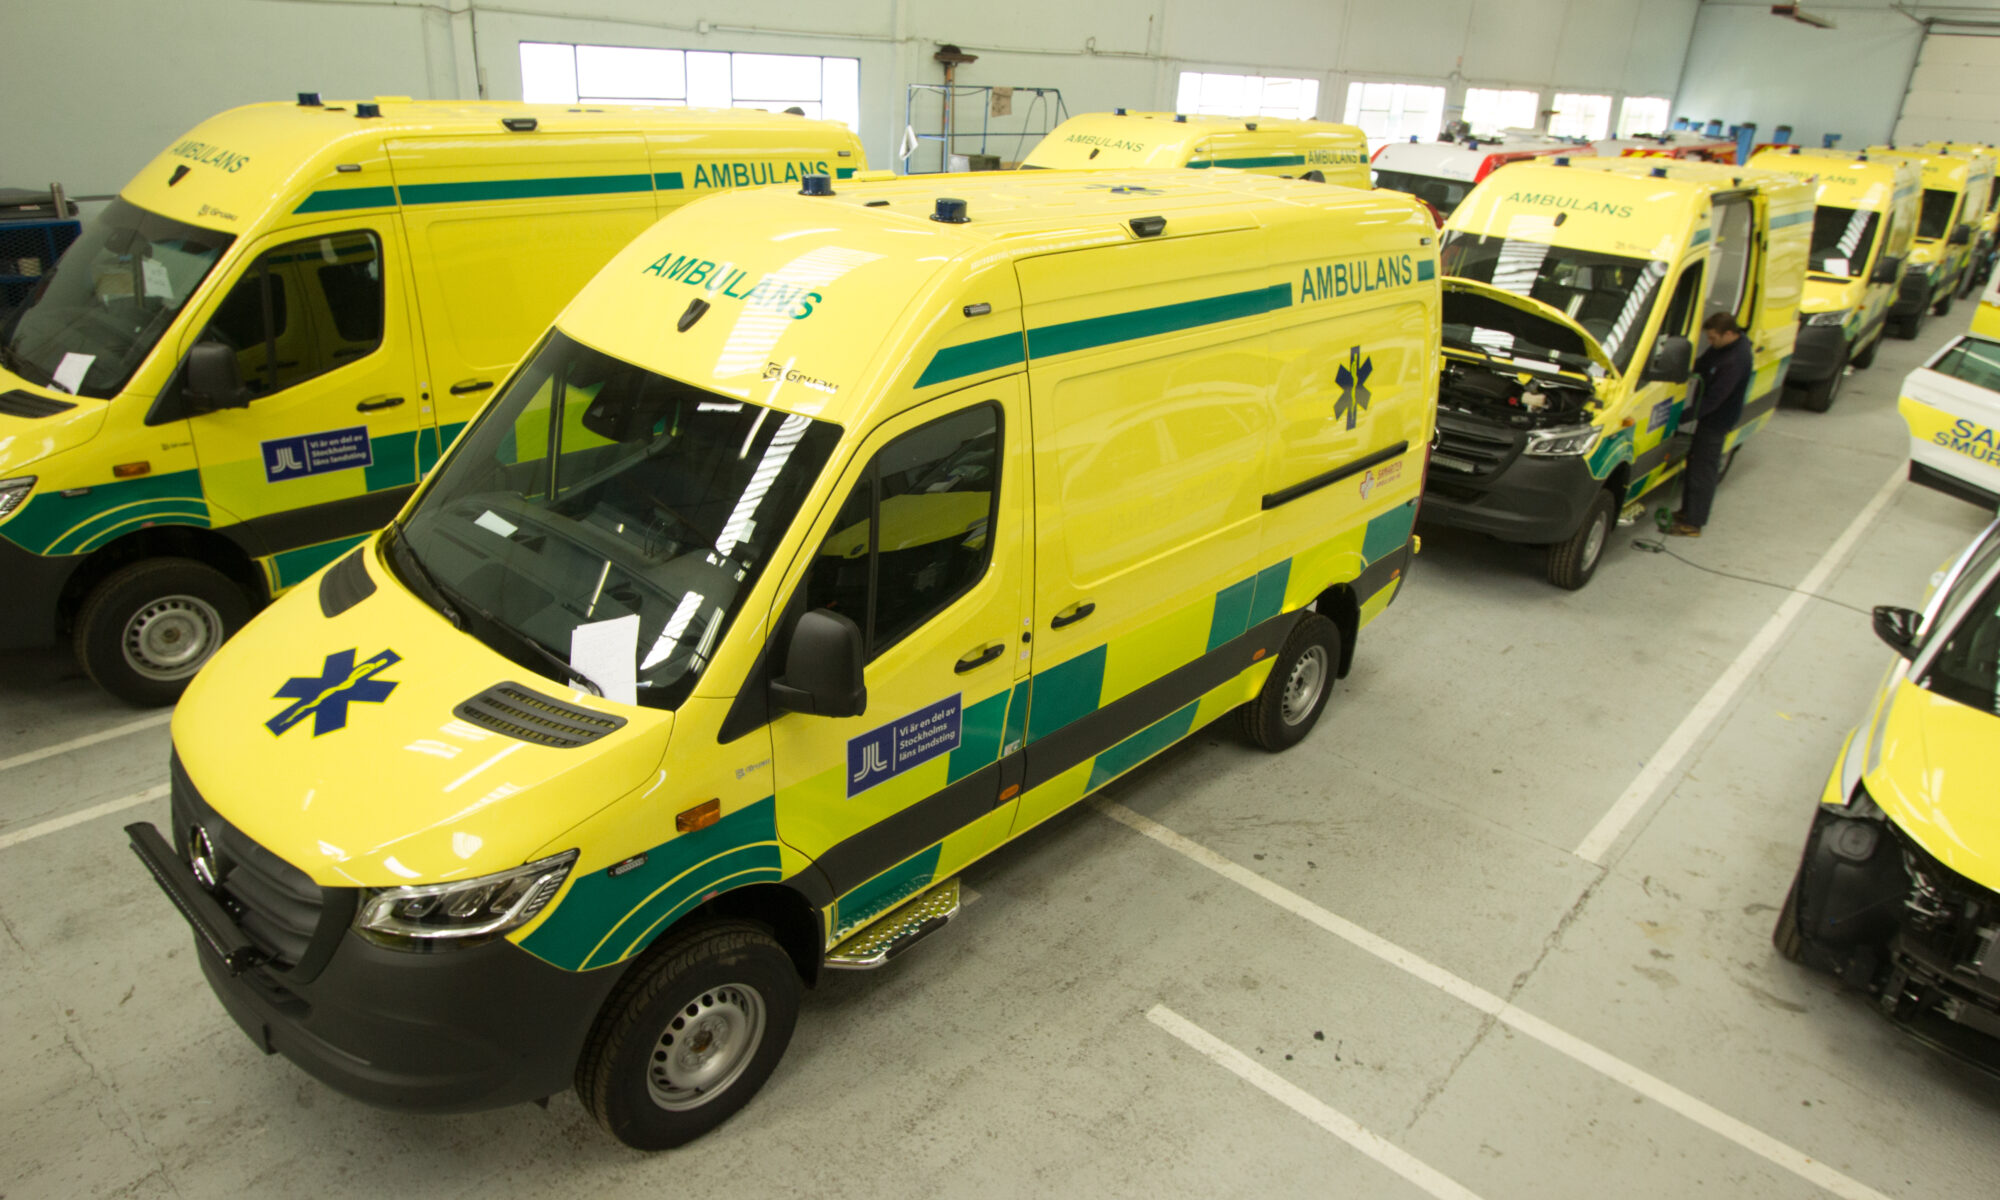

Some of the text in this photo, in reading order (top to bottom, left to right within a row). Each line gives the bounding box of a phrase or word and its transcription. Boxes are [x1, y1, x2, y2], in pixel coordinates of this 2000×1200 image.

[1064, 134, 1144, 152] AMBULANS
[1308, 150, 1357, 164] AMBULANS
[693, 161, 829, 188] AMBULANS
[1507, 192, 1633, 218] AMBULANS
[642, 253, 821, 320] AMBULANS
[1300, 254, 1412, 303] AMBULANS
[899, 707, 956, 736] Vi är en del av
[899, 723, 948, 749] Stockholms
[899, 731, 956, 761] läns landsting
